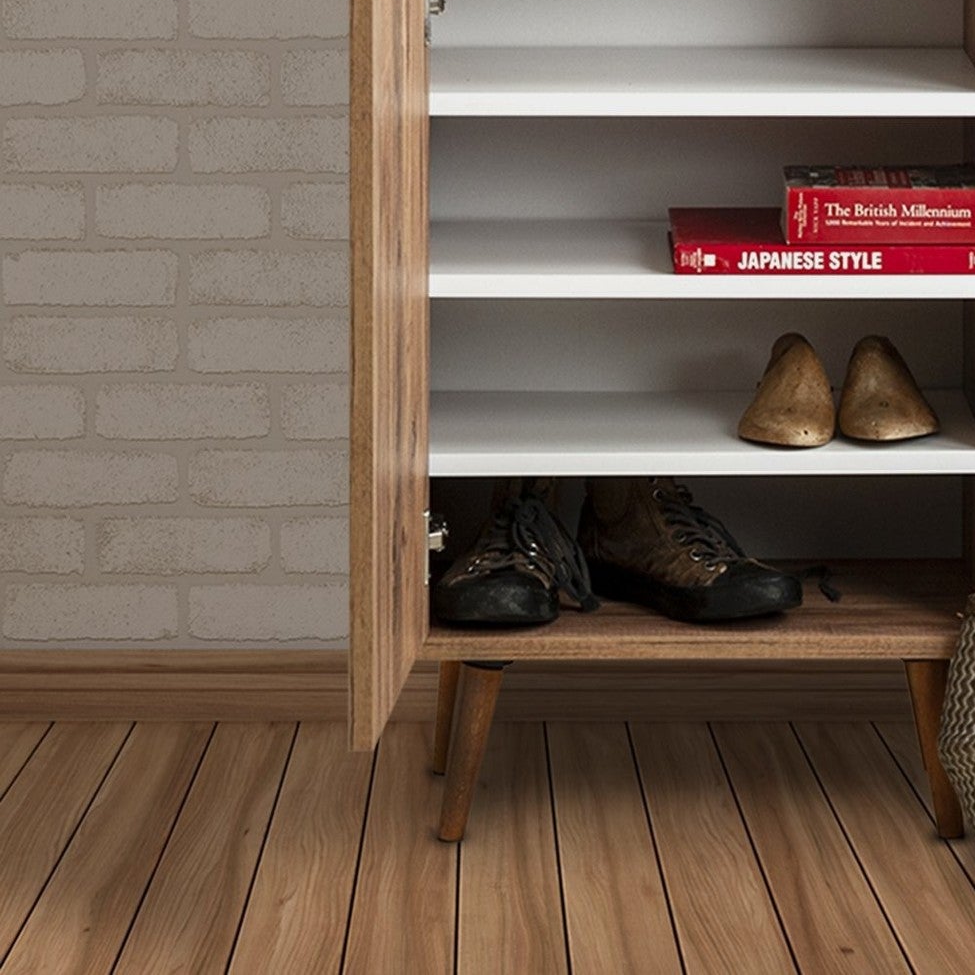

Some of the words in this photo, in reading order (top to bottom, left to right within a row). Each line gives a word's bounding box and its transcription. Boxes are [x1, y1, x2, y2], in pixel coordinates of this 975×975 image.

[824, 202, 851, 217] The
[854, 203, 897, 217] British
[901, 203, 972, 218] Millennium
[737, 251, 824, 270] JAPANESE
[829, 251, 882, 270] STYLE
